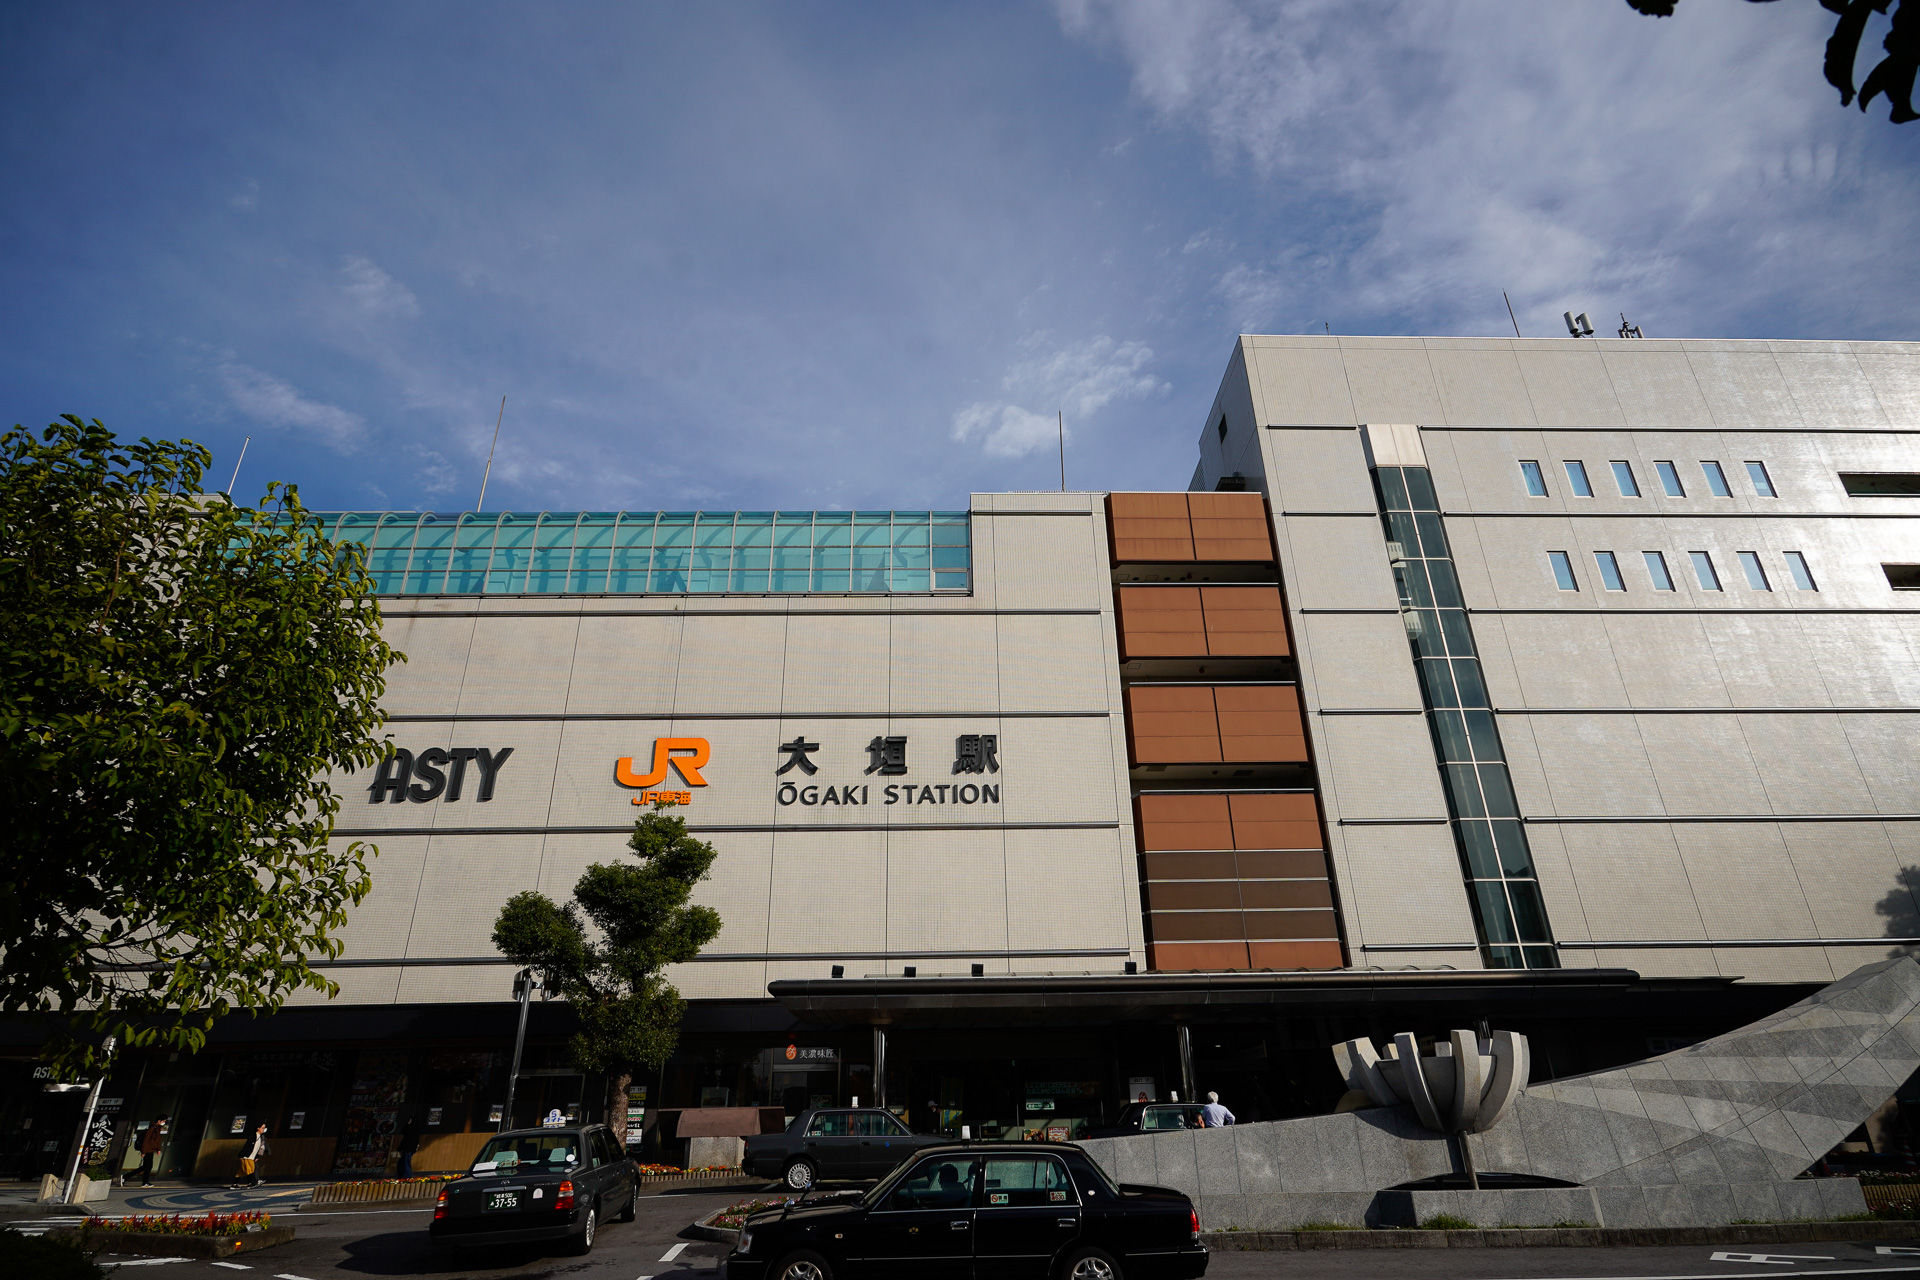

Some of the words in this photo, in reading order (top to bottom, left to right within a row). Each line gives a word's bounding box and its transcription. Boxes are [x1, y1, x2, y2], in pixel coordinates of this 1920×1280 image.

[616, 737, 711, 787] JR
[777, 734, 1001, 776] 大垣駅
[370, 747, 515, 803] ASTY
[778, 781, 869, 806] ŌGAKI
[883, 783, 1001, 806] STATION
[799, 1048, 834, 1059] 美濃味匠
[494, 1197, 518, 1208] 37-55
